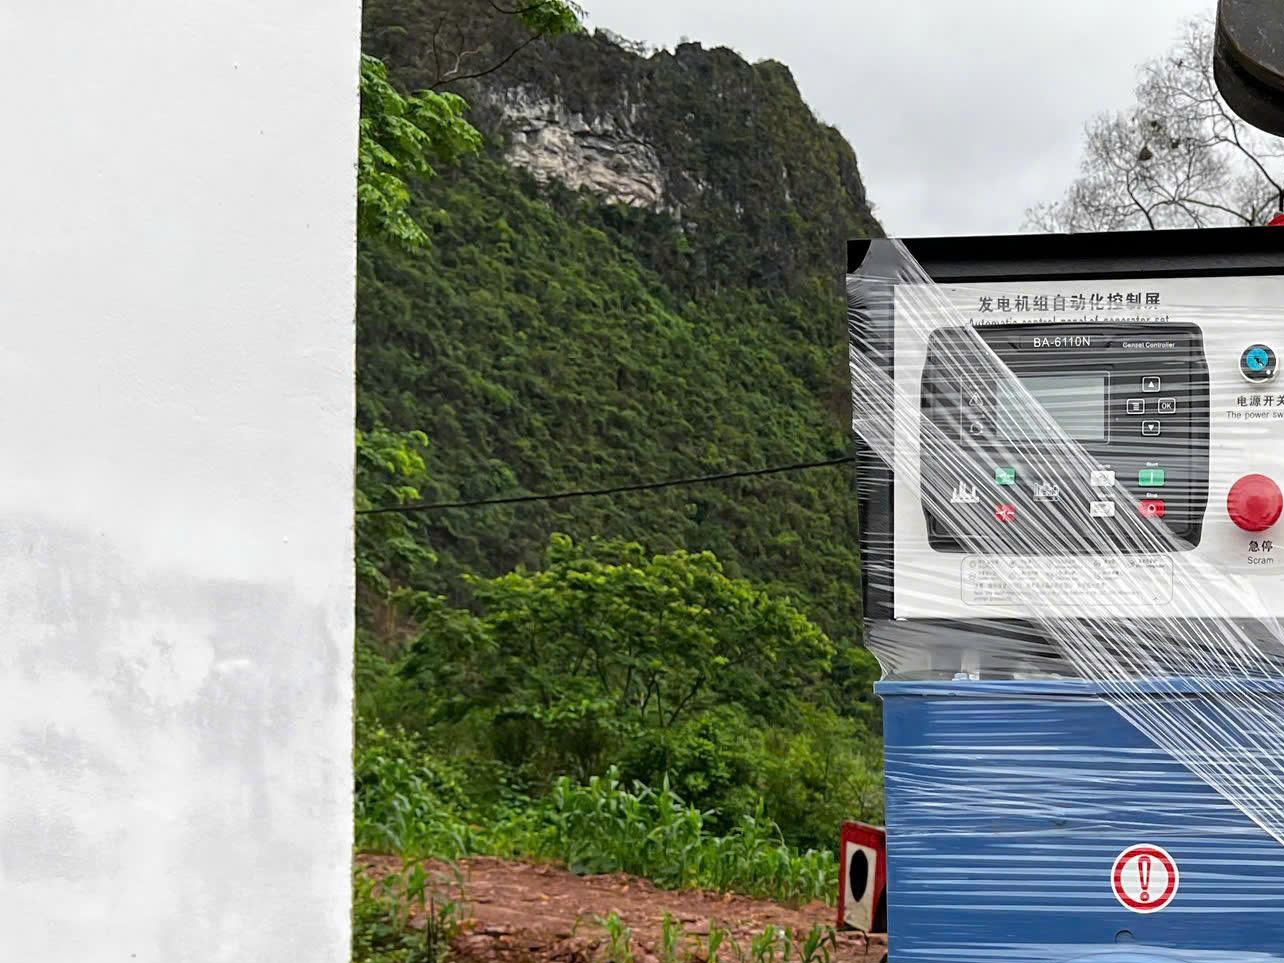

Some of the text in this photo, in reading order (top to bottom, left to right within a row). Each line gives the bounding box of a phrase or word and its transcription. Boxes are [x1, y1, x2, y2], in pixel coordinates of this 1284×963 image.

[978, 292, 1160, 313] 发电机组自动化控制屏
[1033, 337, 1091, 348] BA-6110N
[1161, 402, 1172, 410] OK
[1226, 410, 1242, 419] The
[1244, 411, 1270, 420] power
[1248, 540, 1273, 553] 急停
[1247, 556, 1274, 565] Scram
